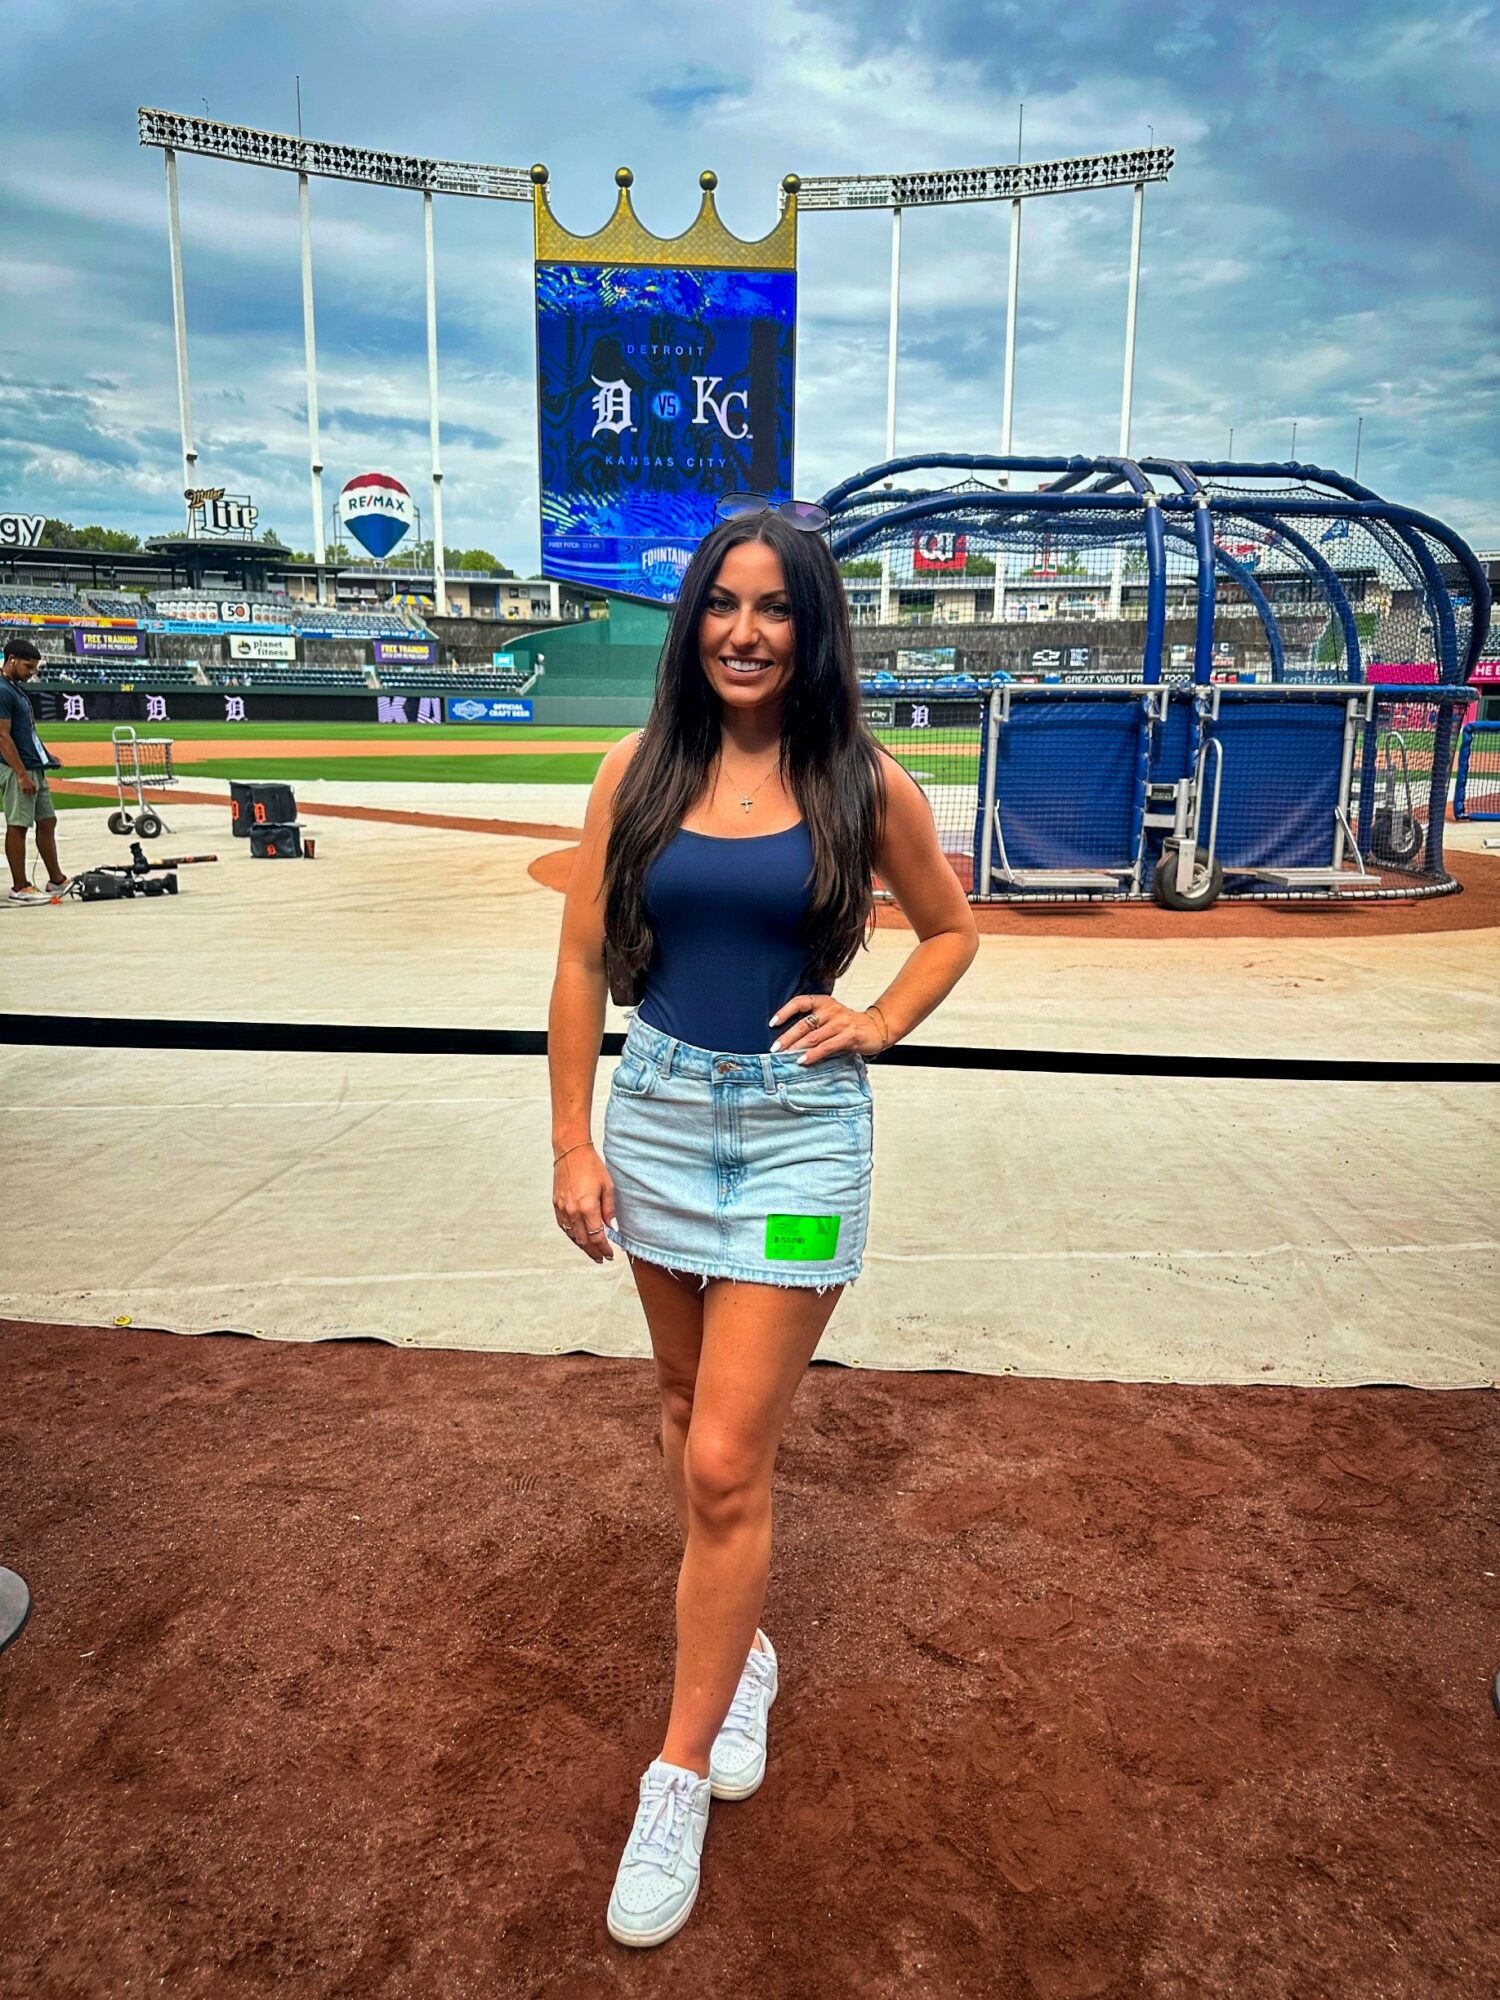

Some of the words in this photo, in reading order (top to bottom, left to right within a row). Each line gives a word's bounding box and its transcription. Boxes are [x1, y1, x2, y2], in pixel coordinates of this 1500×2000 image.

[627, 344, 705, 357] DETROIT
[657, 394, 677, 417] VS
[691, 375, 749, 440] KC
[605, 455, 675, 468] KANSAS
[686, 458, 728, 468] CITY
[184, 488, 226, 509] Miller
[348, 494, 405, 513] RE/MAX
[201, 499, 259, 535] Lite
[83, 634, 101, 645] FREE
[102, 635, 137, 646] TRAINING
[253, 639, 283, 649] planet
[257, 648, 289, 657] fitness
[1064, 674, 1095, 684] GREAT
[1095, 674, 1125, 683] VIEWS
